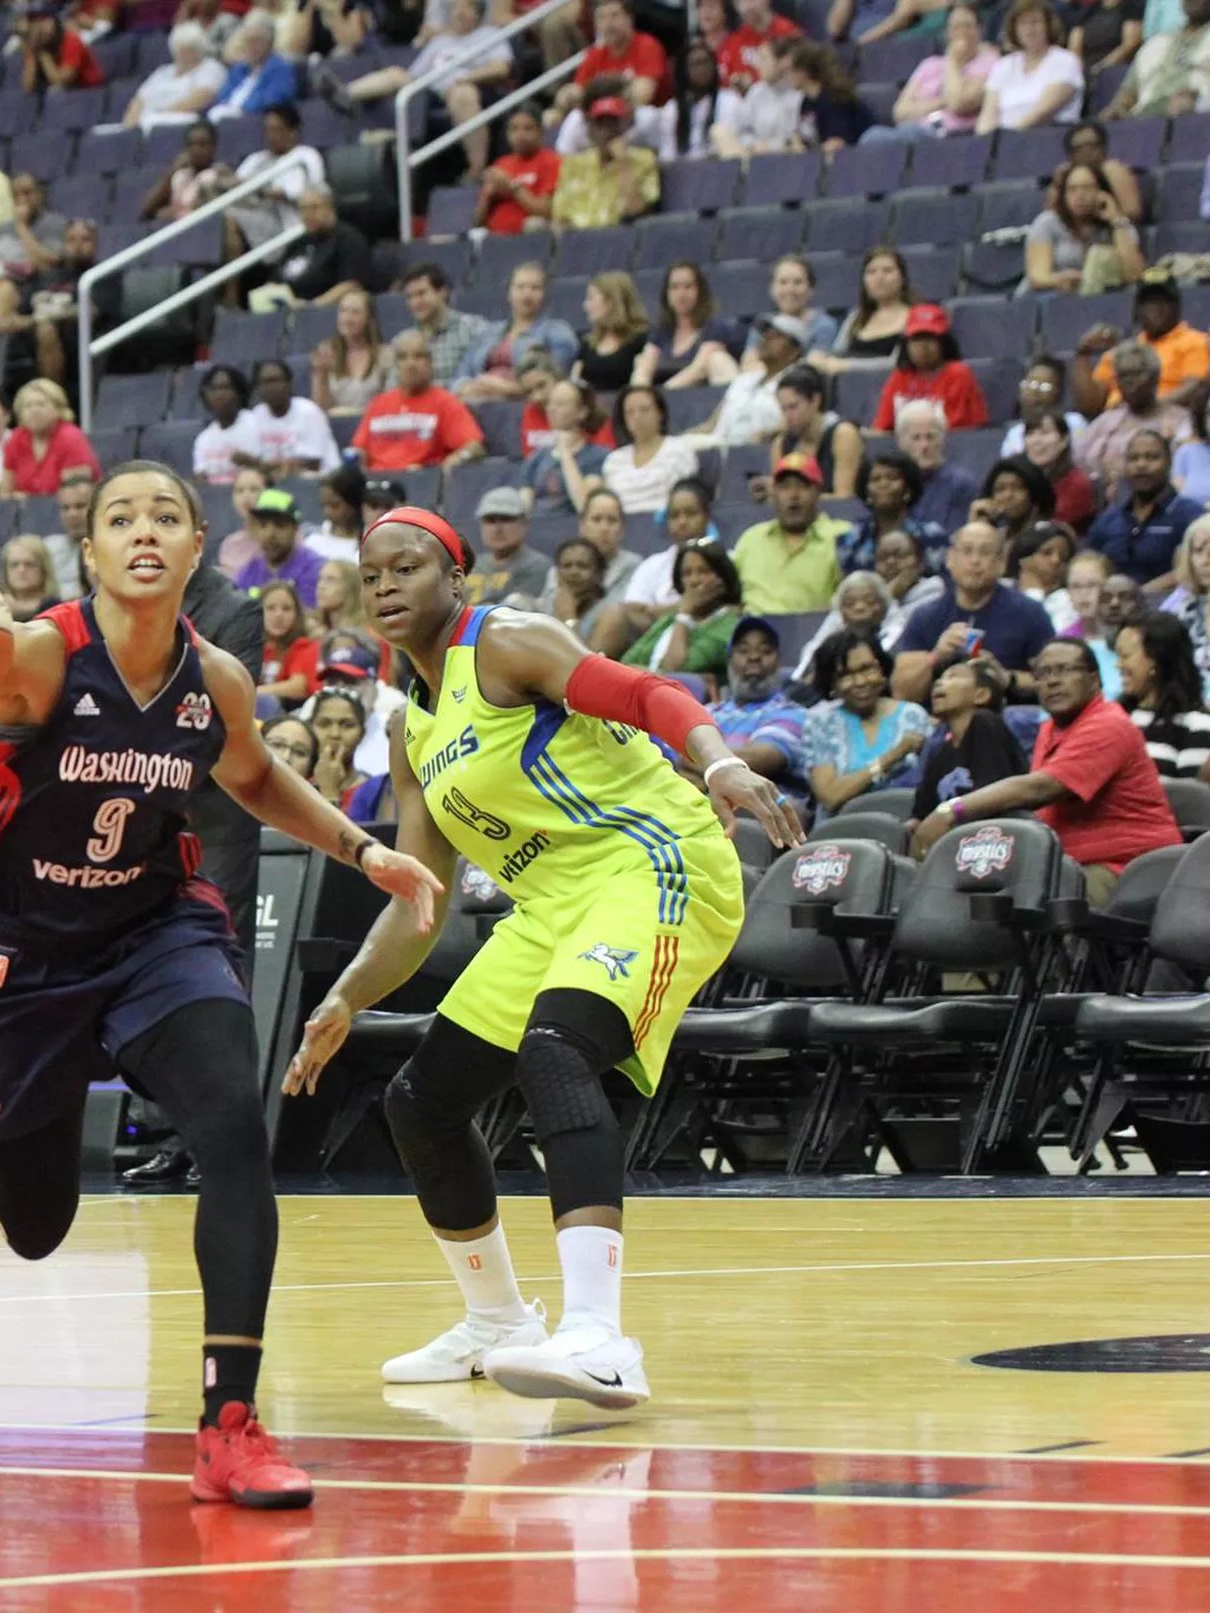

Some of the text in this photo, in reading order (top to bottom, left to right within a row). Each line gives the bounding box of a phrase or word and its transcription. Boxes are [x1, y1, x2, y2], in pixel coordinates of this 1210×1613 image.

[59, 746, 193, 794] Washington
[87, 797, 135, 863] 9
[442, 786, 511, 841] 13
[32, 857, 142, 888] verizon
